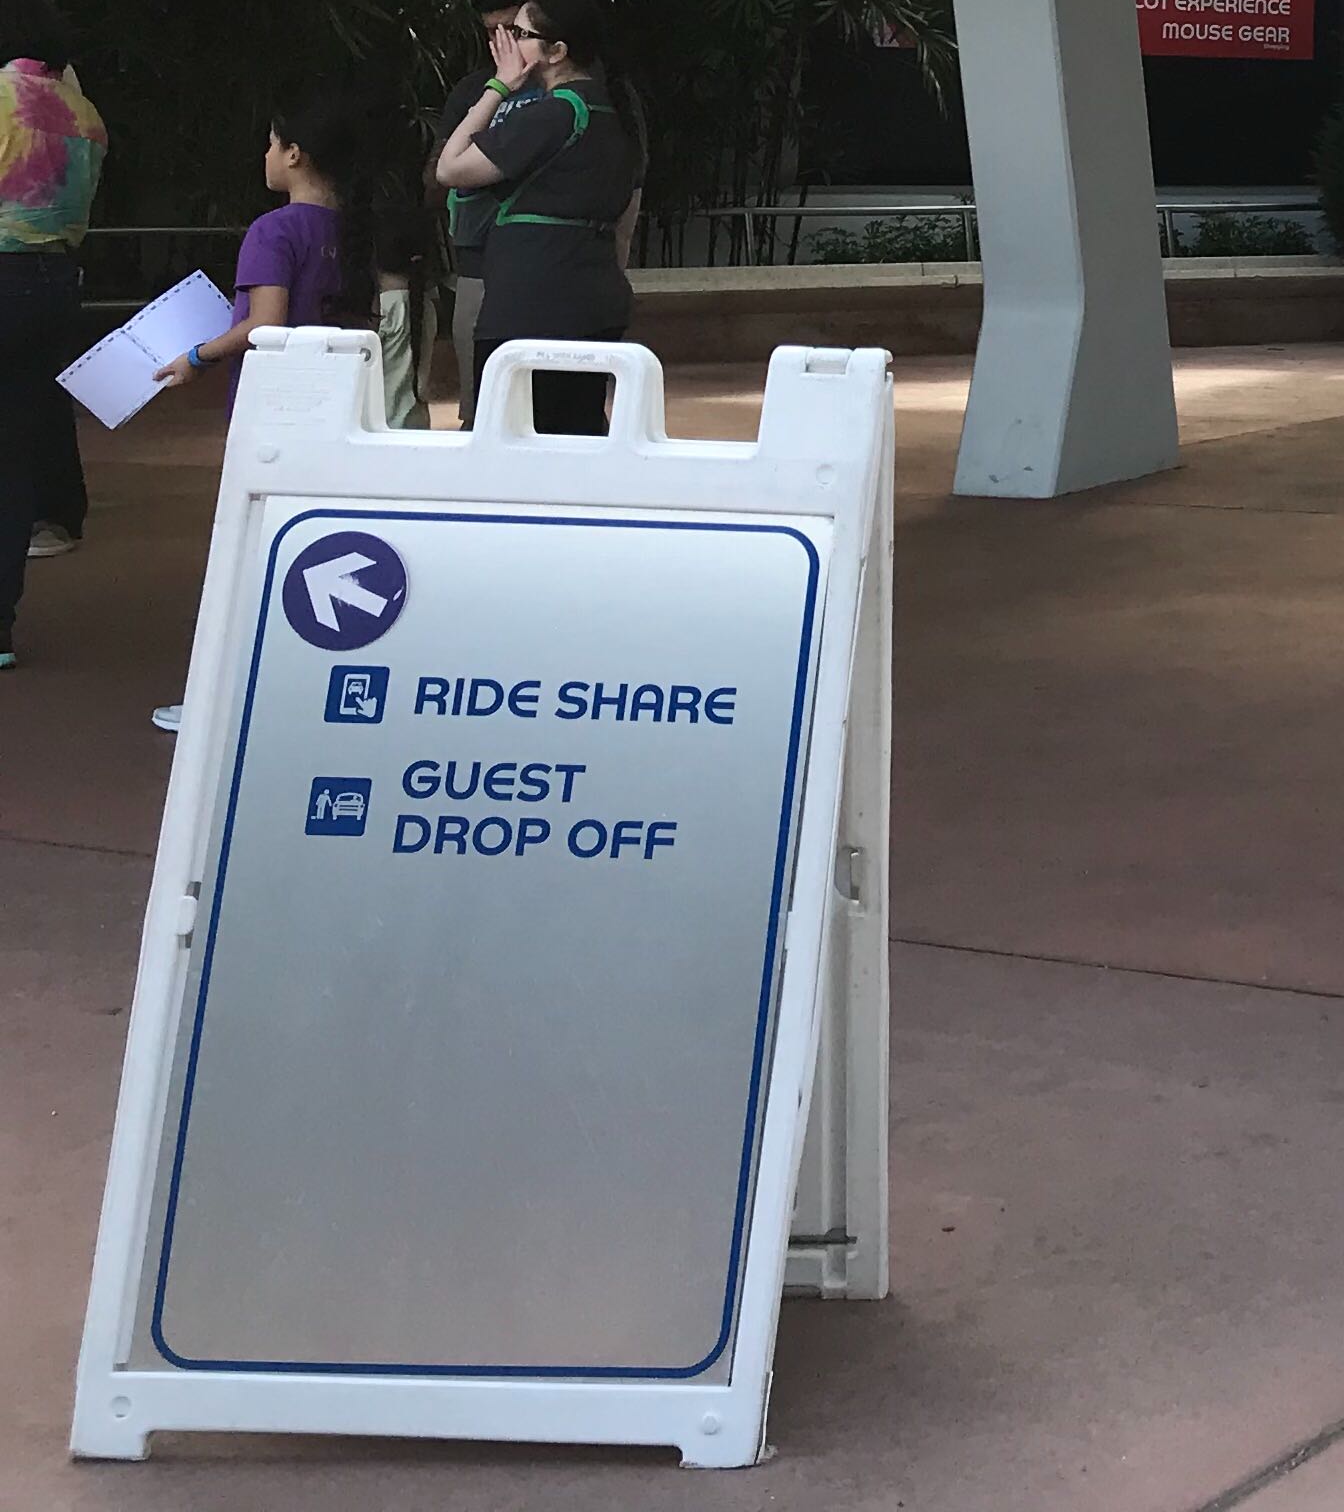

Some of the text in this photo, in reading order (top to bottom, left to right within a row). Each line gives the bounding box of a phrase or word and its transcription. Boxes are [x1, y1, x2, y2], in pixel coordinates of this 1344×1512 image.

[1162, 23, 1290, 43] MOUSE GEAR
[413, 676, 737, 725] RIDE SHARE
[402, 760, 586, 802] GUEST
[392, 815, 678, 860] DROP OFF
